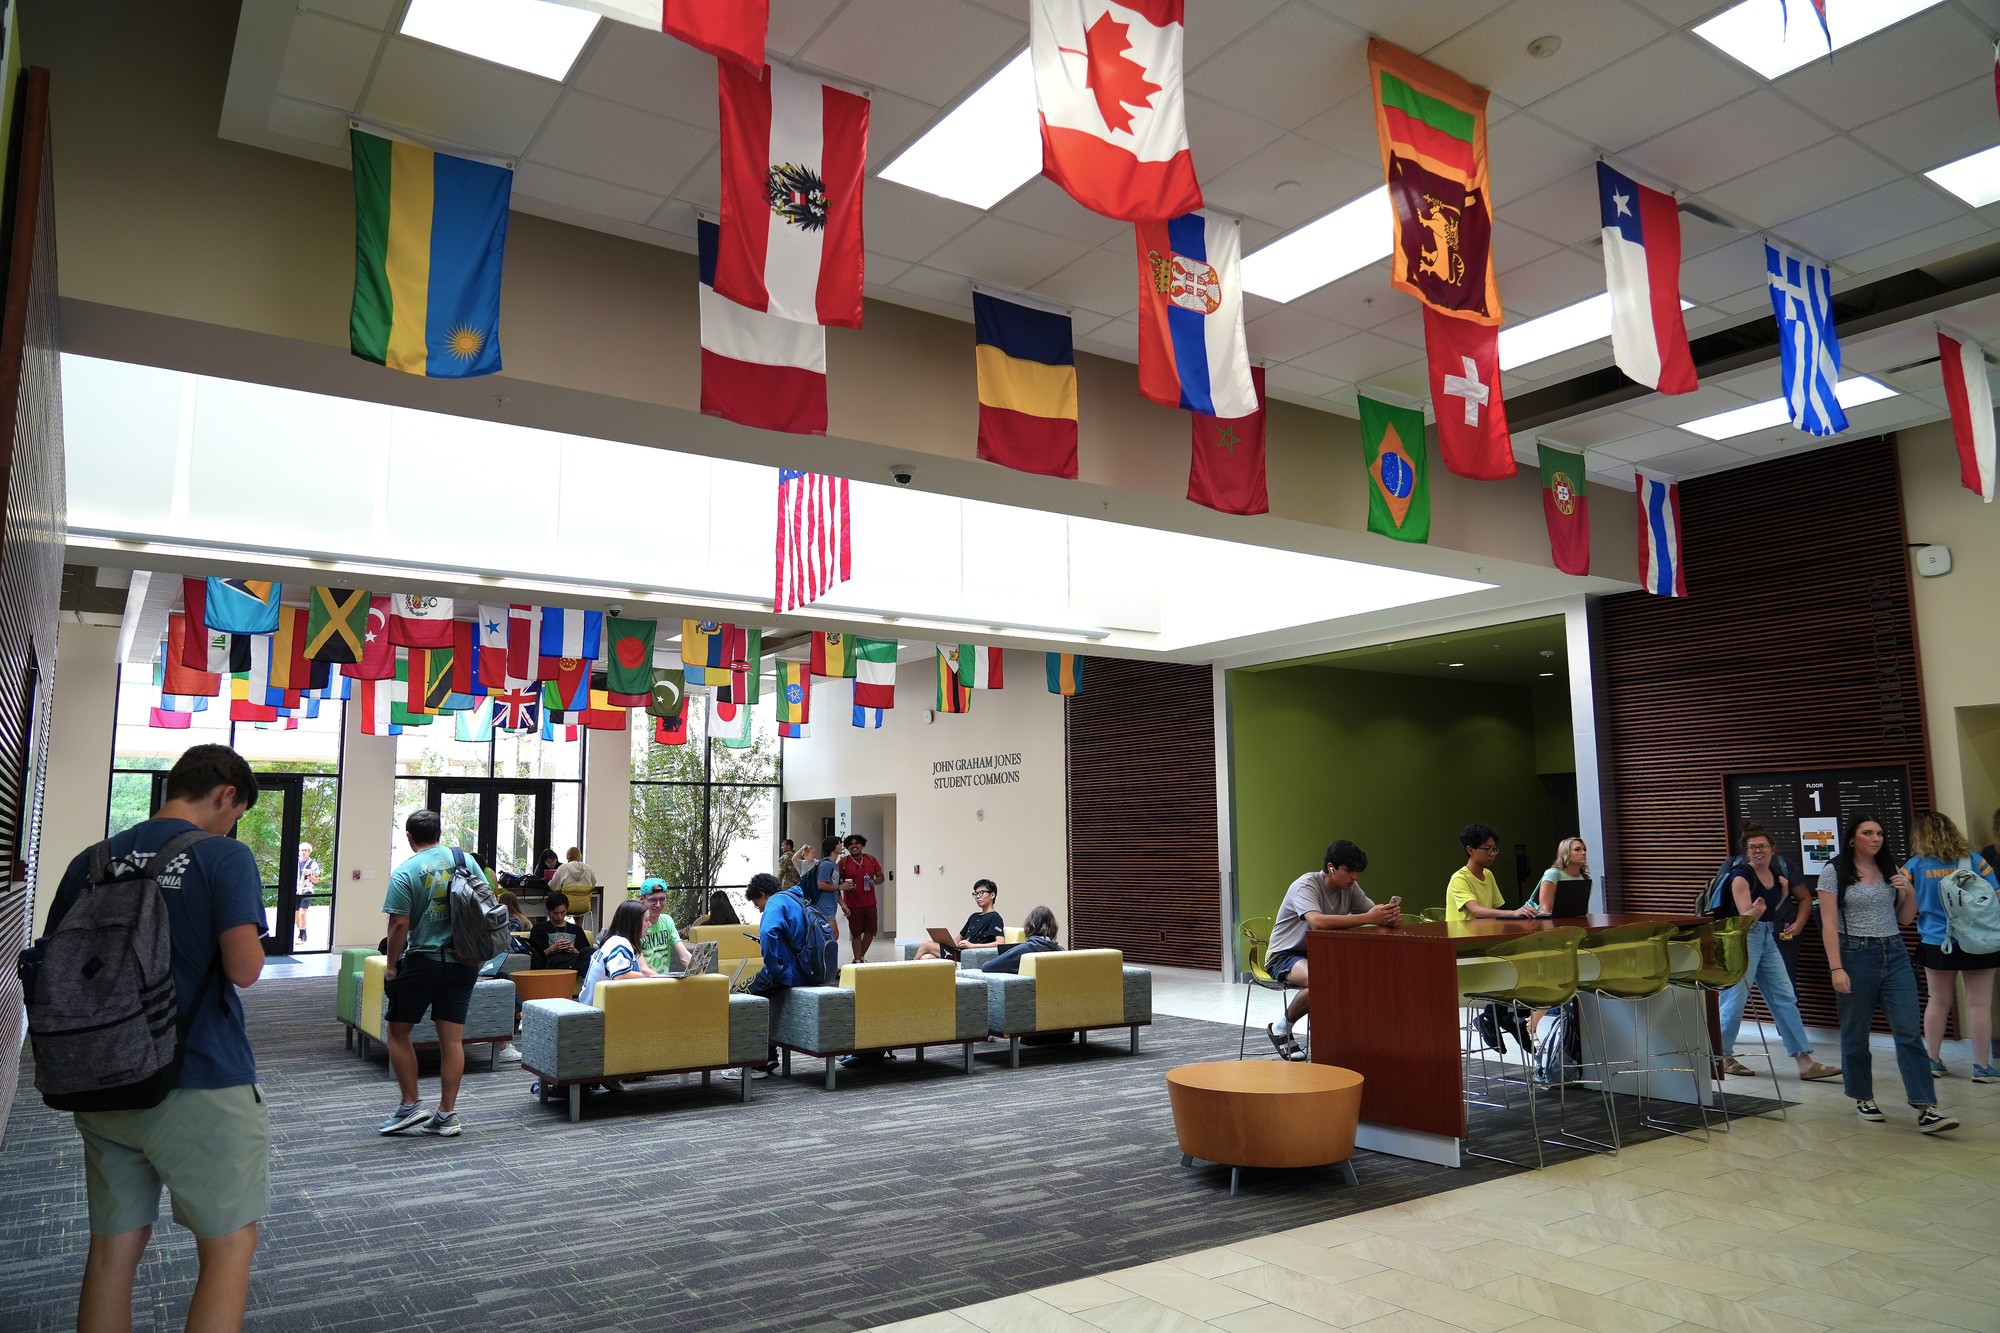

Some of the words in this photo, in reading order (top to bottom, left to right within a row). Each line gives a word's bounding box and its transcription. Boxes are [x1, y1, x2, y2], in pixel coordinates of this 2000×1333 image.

[1866, 575, 1908, 747] DIRECTORY
[932, 760, 954, 775] JOHN
[955, 755, 993, 771] GRAHAM
[994, 752, 1022, 769] JONES
[933, 775, 972, 789] STUDENT
[973, 771, 1020, 786] COMMONS
[1809, 790, 1821, 812] 1
[641, 929, 669, 950] BAYLOR
